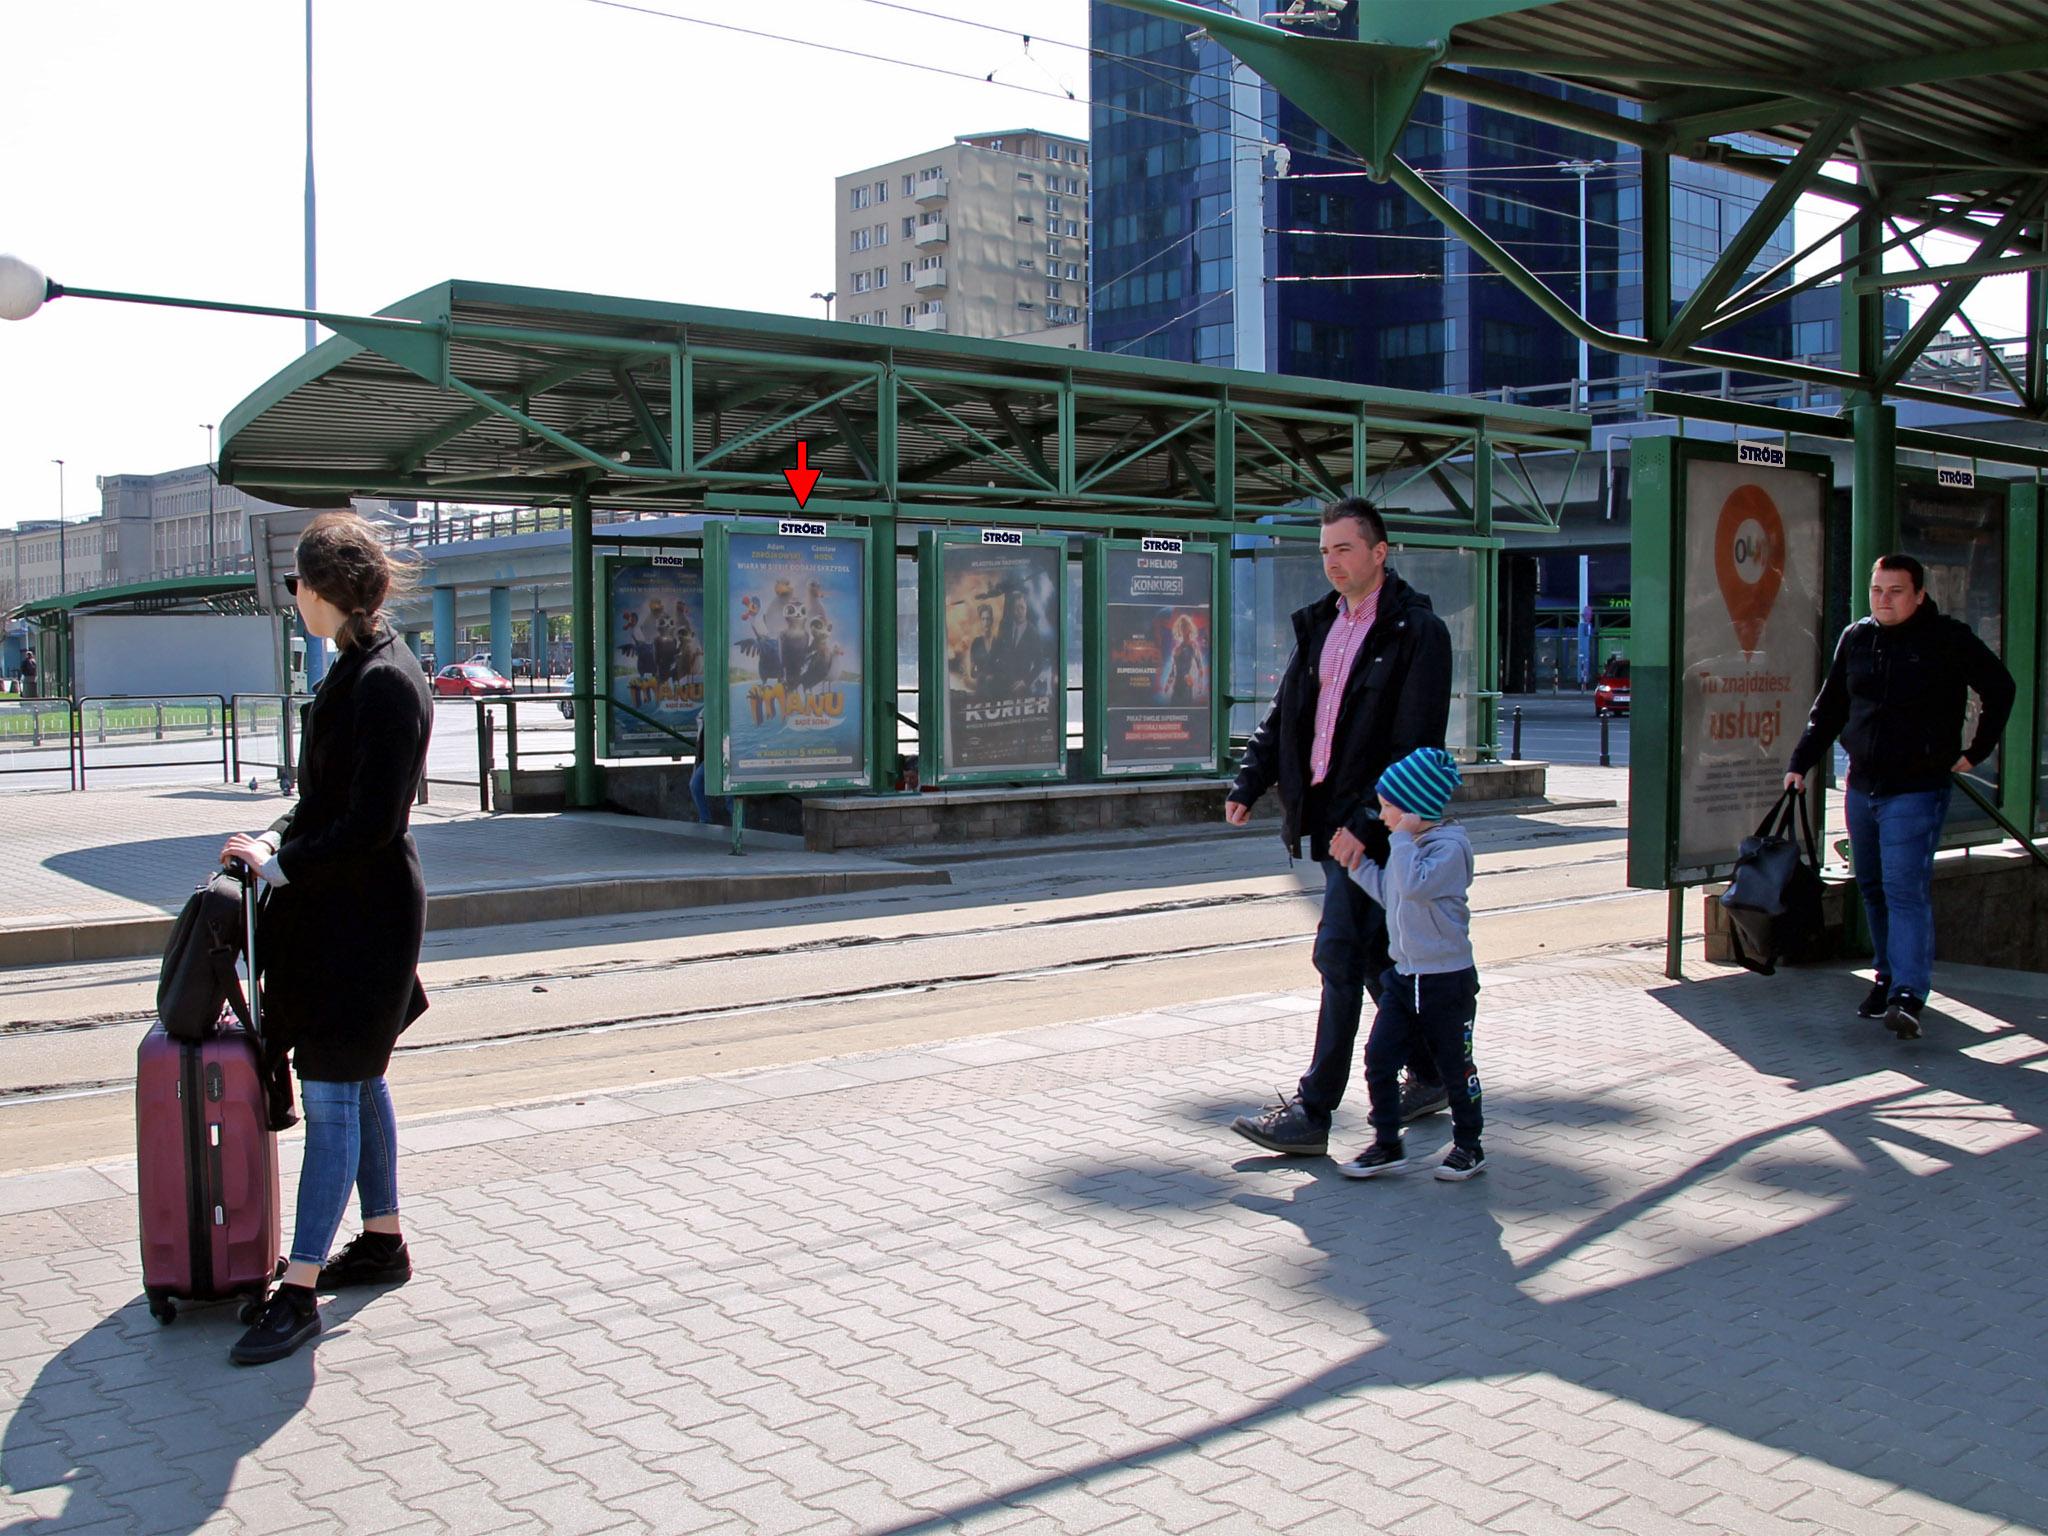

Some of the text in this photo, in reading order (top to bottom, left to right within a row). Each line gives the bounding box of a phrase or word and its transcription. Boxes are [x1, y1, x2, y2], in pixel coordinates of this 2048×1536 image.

[1740, 445, 1784, 464] STRÖER
[1939, 470, 1973, 486] STRÖER
[780, 522, 825, 535] STRÖER
[983, 532, 1021, 544] STRÖER
[1143, 540, 1181, 552] STRÖER
[654, 556, 683, 566] STRÖER
[1149, 559, 1178, 569] HELIOS
[1133, 580, 1181, 592] KONKURS!
[1699, 671, 1792, 697] Tu znajdziesz
[746, 683, 844, 728] MANU
[965, 696, 1050, 721] KURIER
[1710, 699, 1782, 747] usługi
